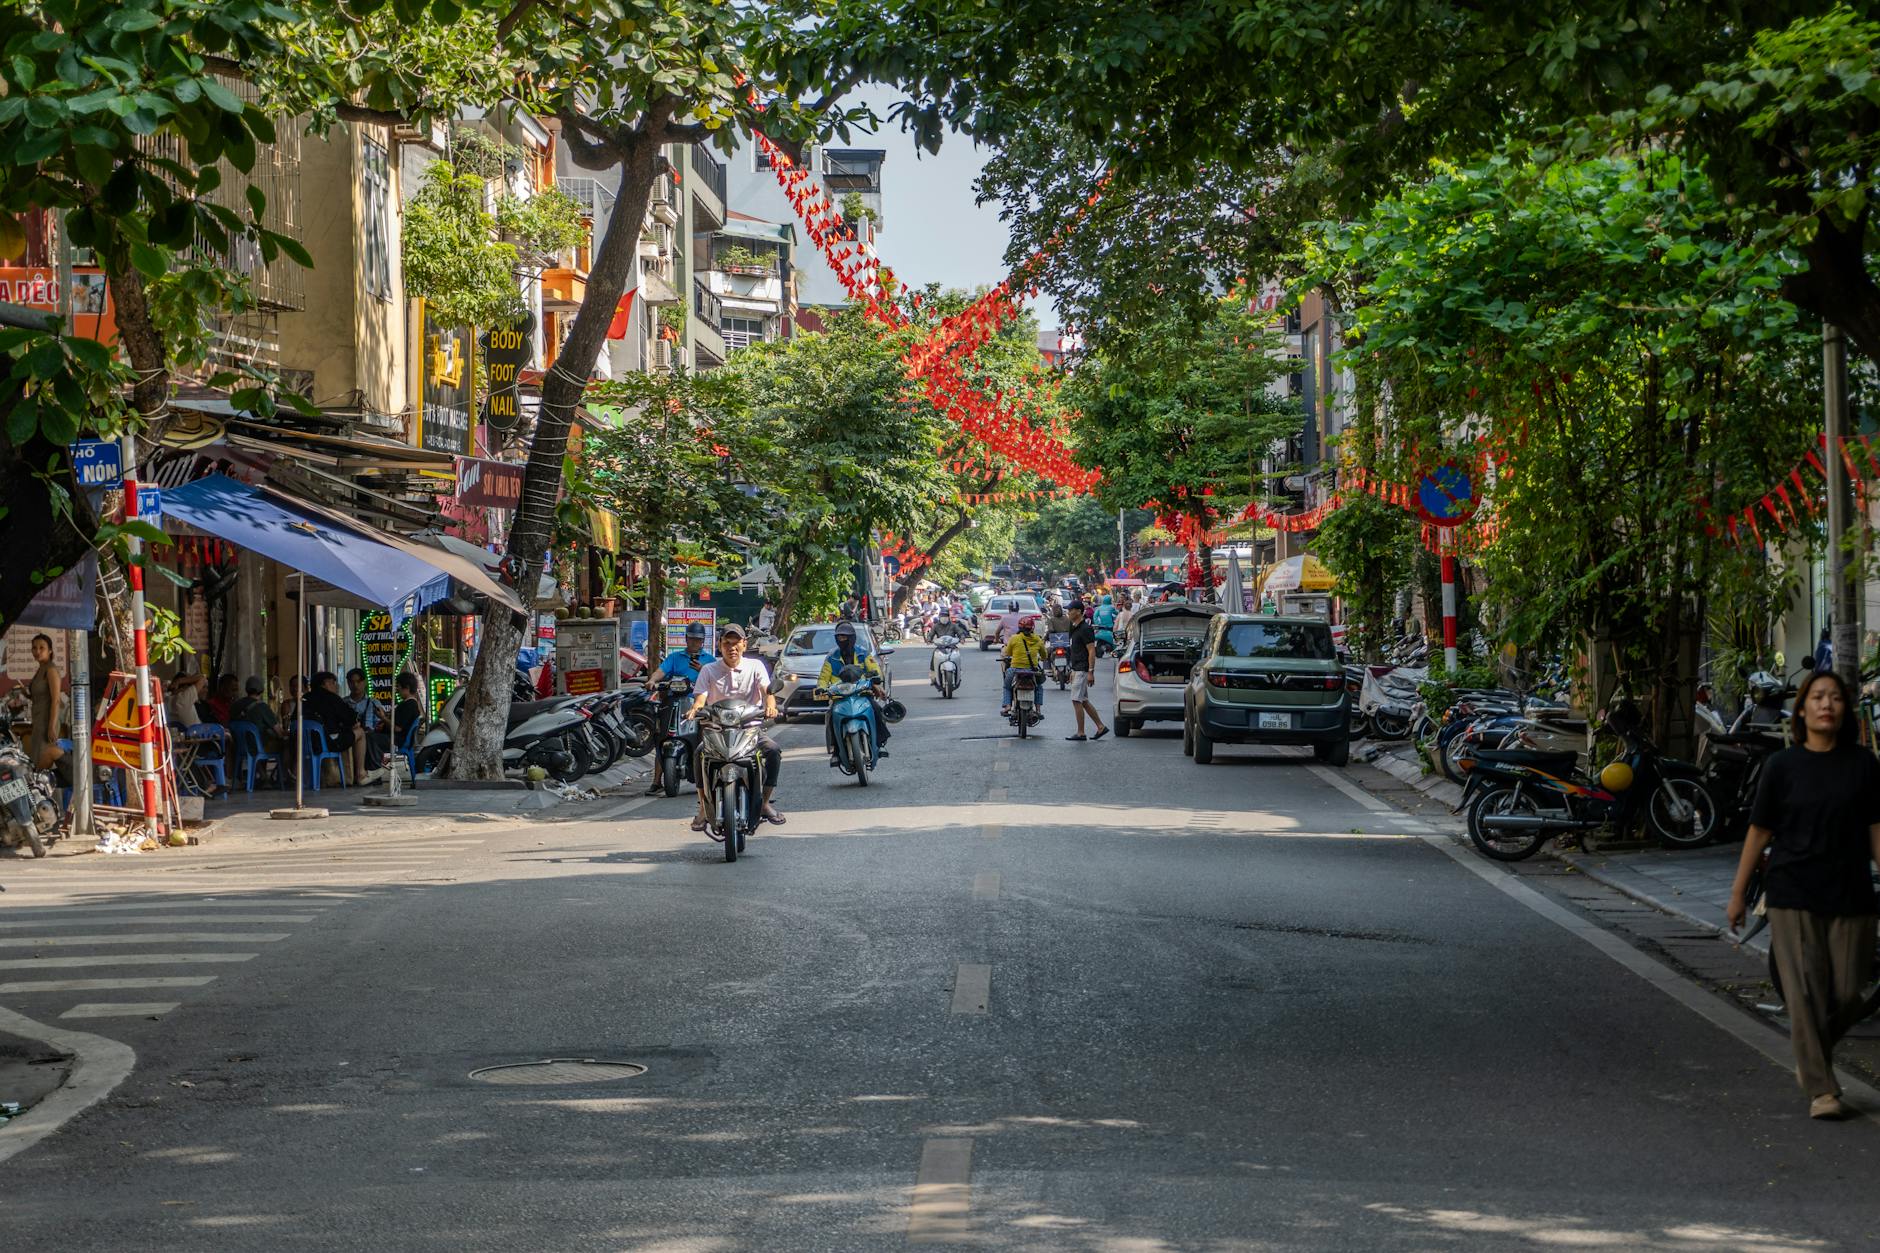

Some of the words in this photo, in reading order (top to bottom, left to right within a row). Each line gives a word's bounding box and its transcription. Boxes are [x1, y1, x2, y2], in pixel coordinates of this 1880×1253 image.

[15, 272, 61, 304] DẺO
[490, 331, 523, 350] BODY
[490, 364, 515, 382] FOOT
[490, 396, 516, 416] NAIL
[83, 460, 117, 482] NÓN
[369, 614, 391, 631] SP
[686, 611, 713, 619] EXCHANGE
[367, 655, 381, 664] FOOT
[372, 691, 393, 699] FACIA
